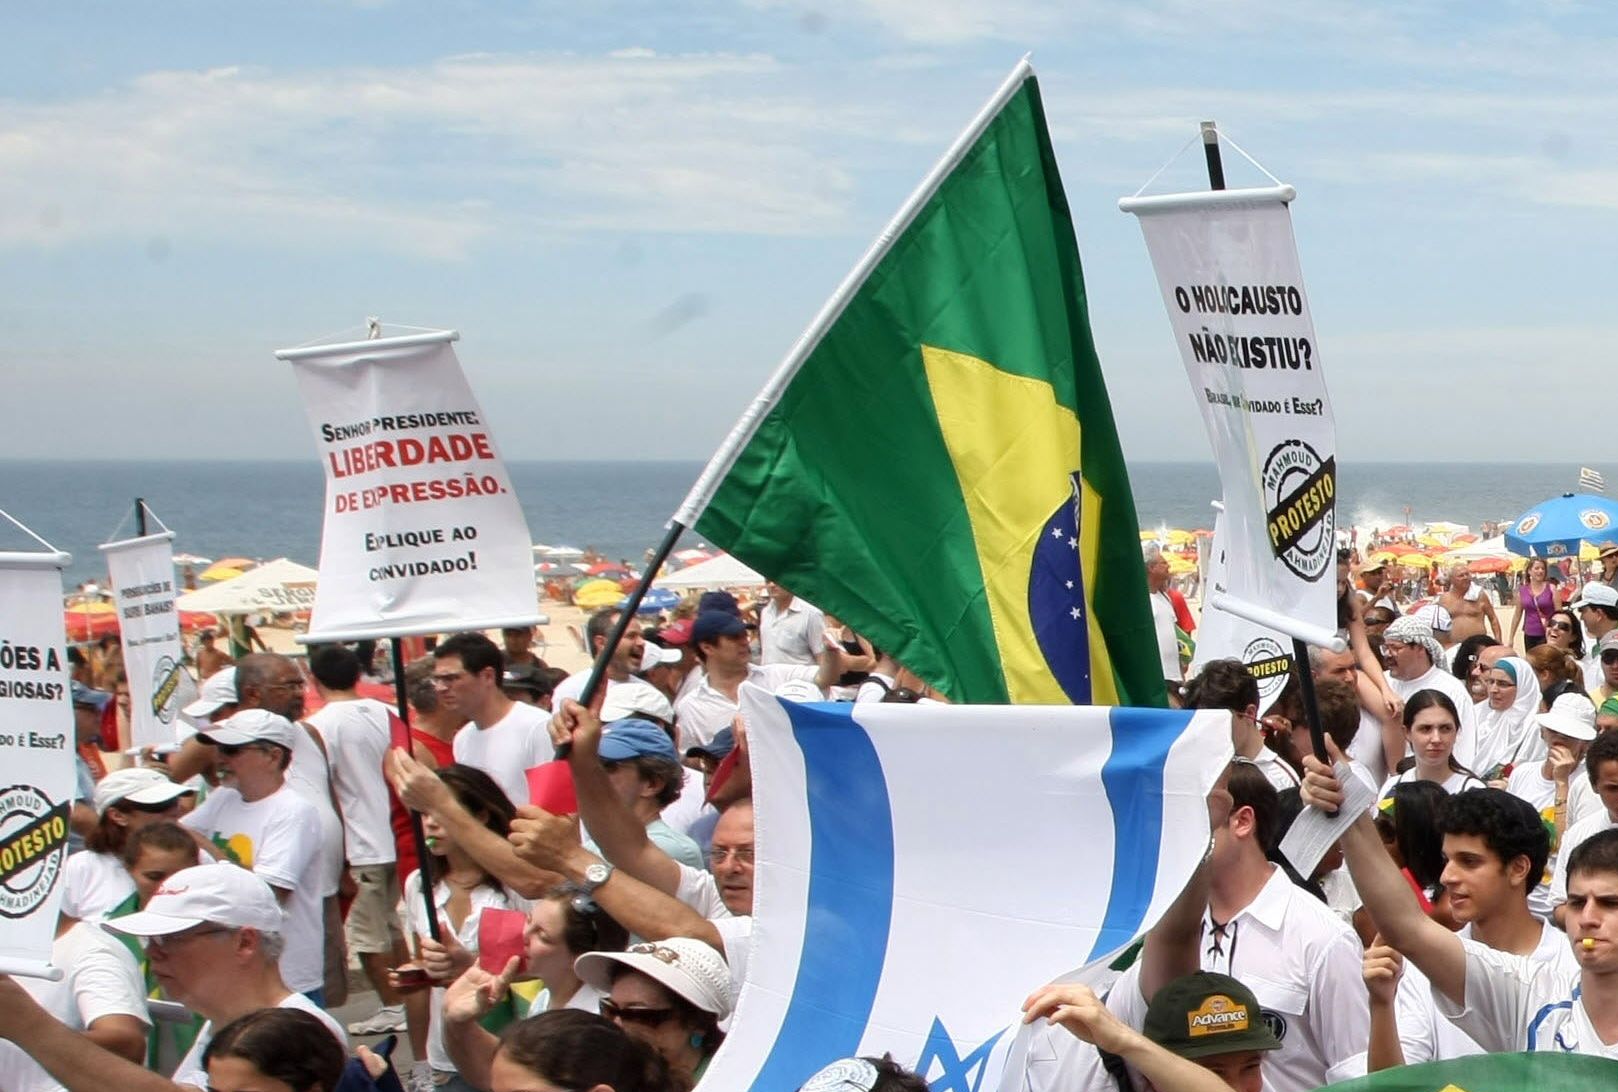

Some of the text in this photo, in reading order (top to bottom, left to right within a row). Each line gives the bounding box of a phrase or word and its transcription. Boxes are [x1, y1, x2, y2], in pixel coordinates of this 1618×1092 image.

[1175, 286, 1190, 313] O
[1188, 326, 1227, 364] NÃO
[329, 432, 495, 480] LIBERDADE
[1267, 451, 1313, 490] MAHMOUD
[335, 493, 359, 513] DE
[1270, 473, 1333, 547] PROTESTO
[451, 526, 477, 541] AO
[47, 647, 61, 671] A
[1246, 658, 1288, 681] OTESTO
[0, 816, 65, 876] OTESTO
